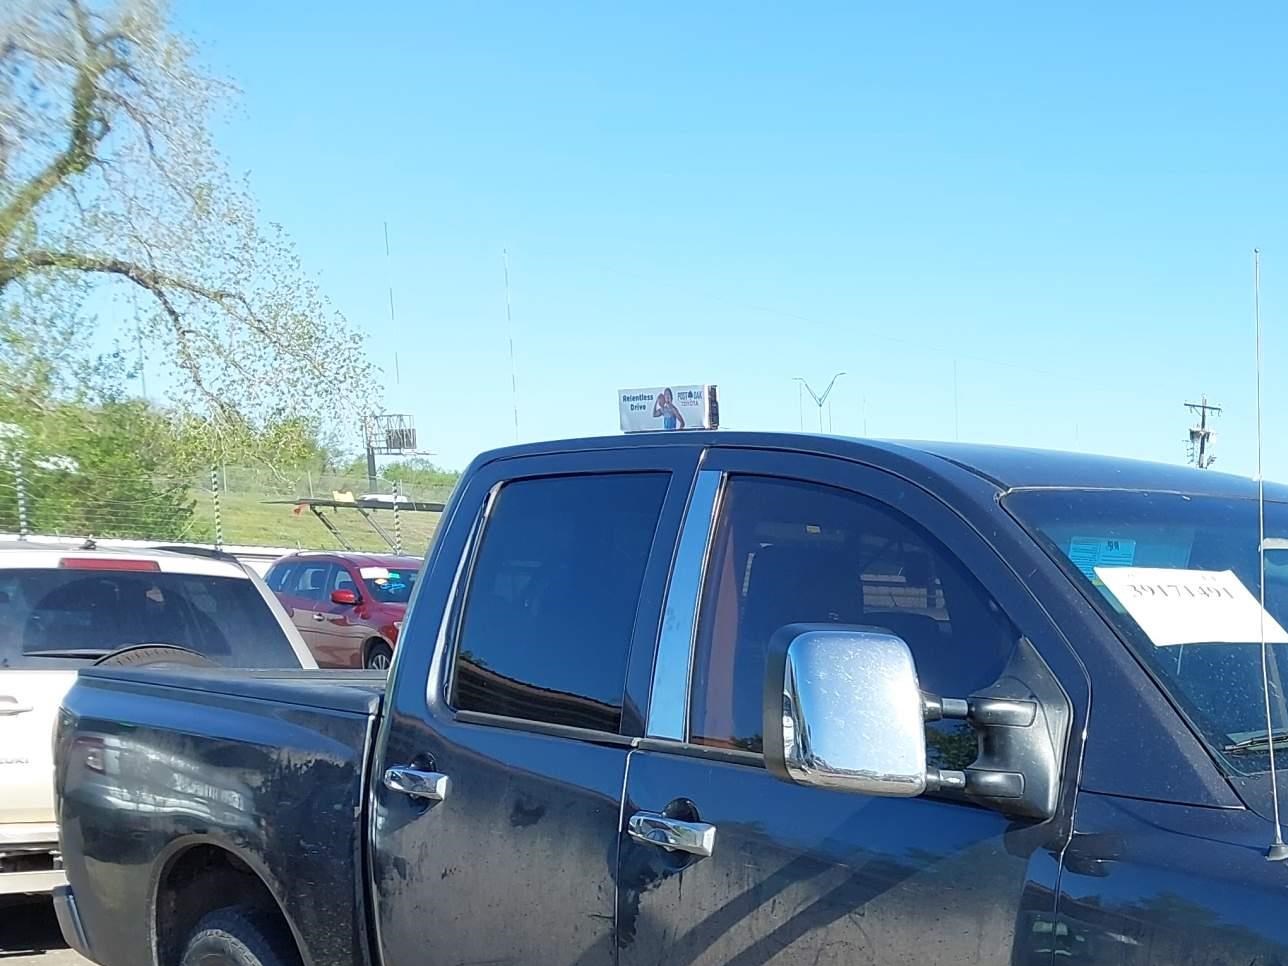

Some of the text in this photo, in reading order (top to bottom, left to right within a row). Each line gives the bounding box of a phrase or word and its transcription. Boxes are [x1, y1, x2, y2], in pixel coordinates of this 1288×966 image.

[622, 393, 654, 403] Relentless
[630, 403, 646, 411] Drive
[1127, 583, 1235, 600] 39171491
